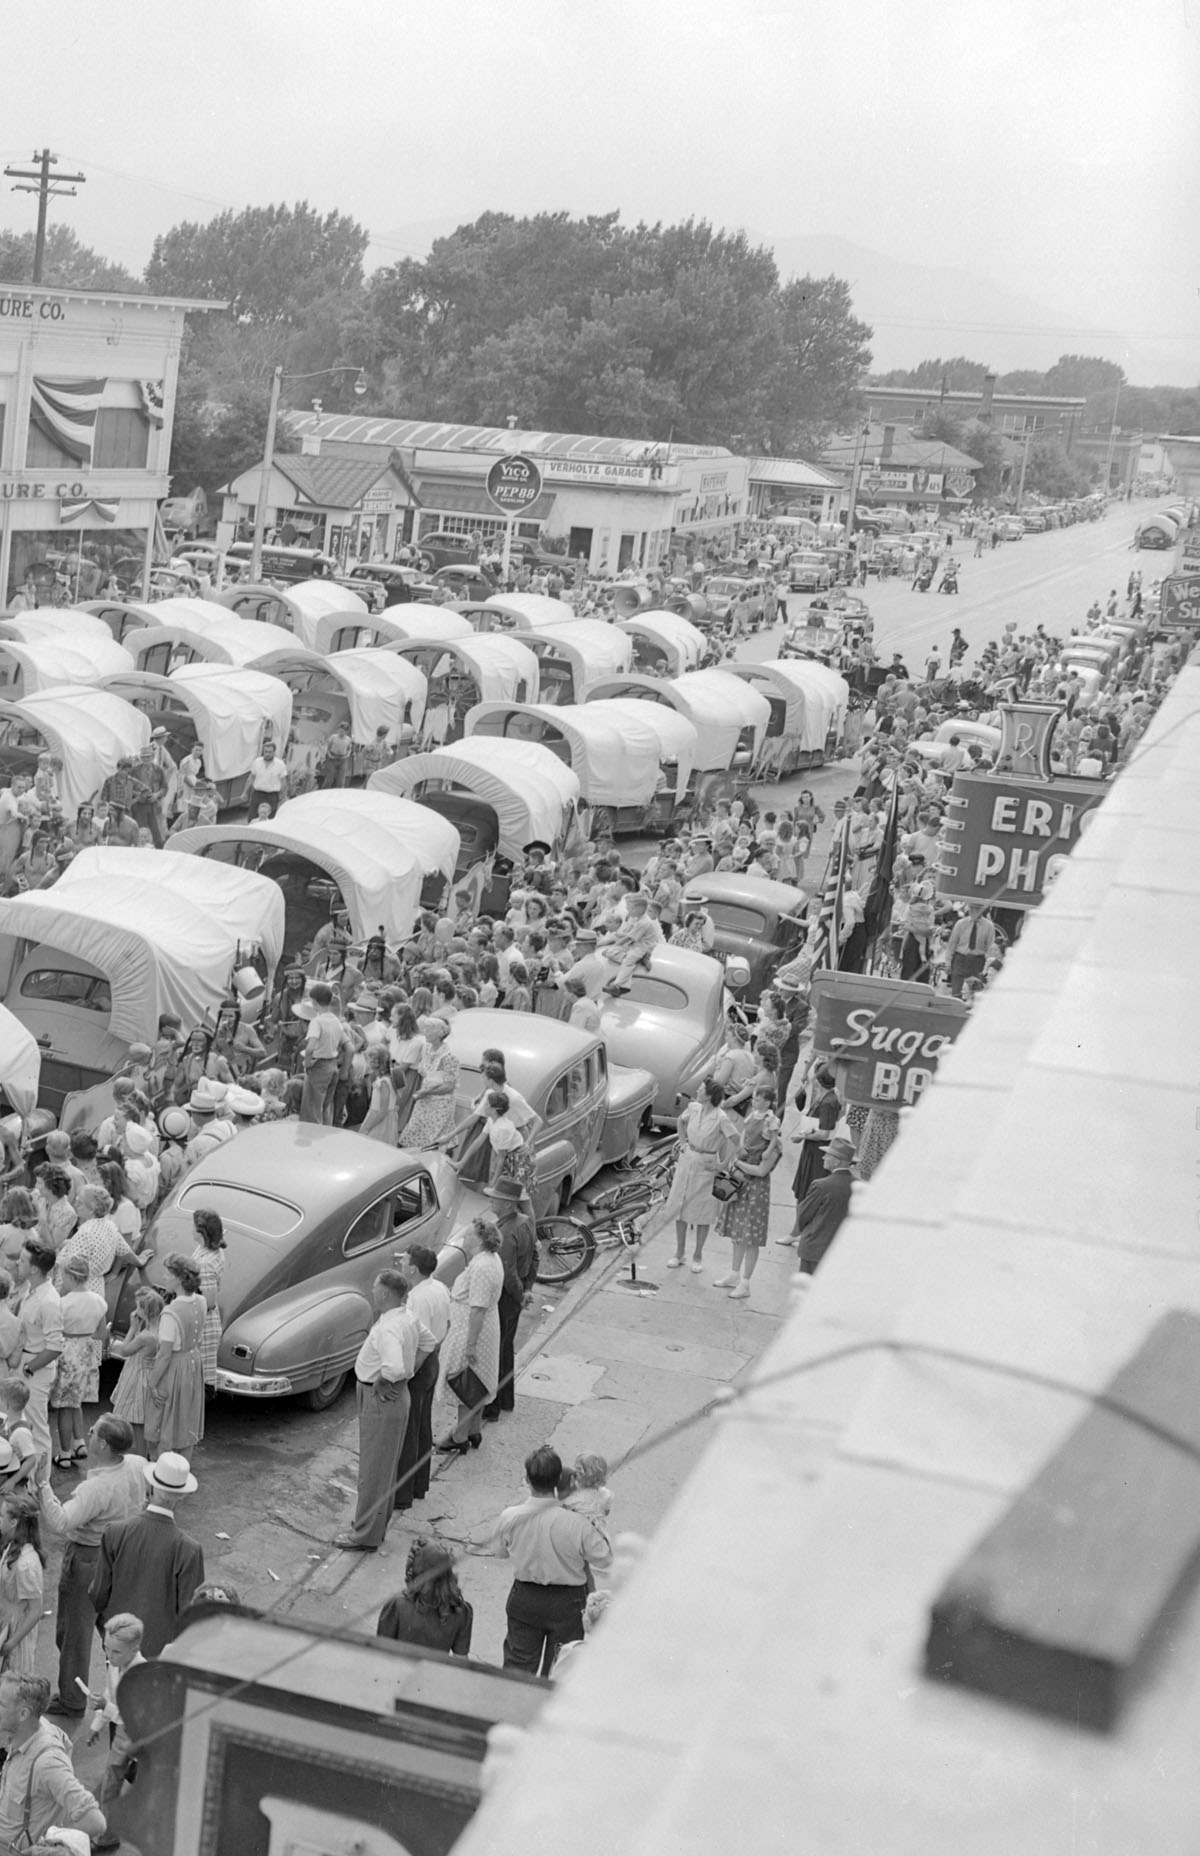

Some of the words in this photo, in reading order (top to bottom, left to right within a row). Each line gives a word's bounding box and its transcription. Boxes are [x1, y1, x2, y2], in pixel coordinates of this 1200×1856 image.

[550, 462, 600, 475] VERHOLTZ
[604, 467, 644, 479] GARAGE
[56, 483, 88, 499] CO.
